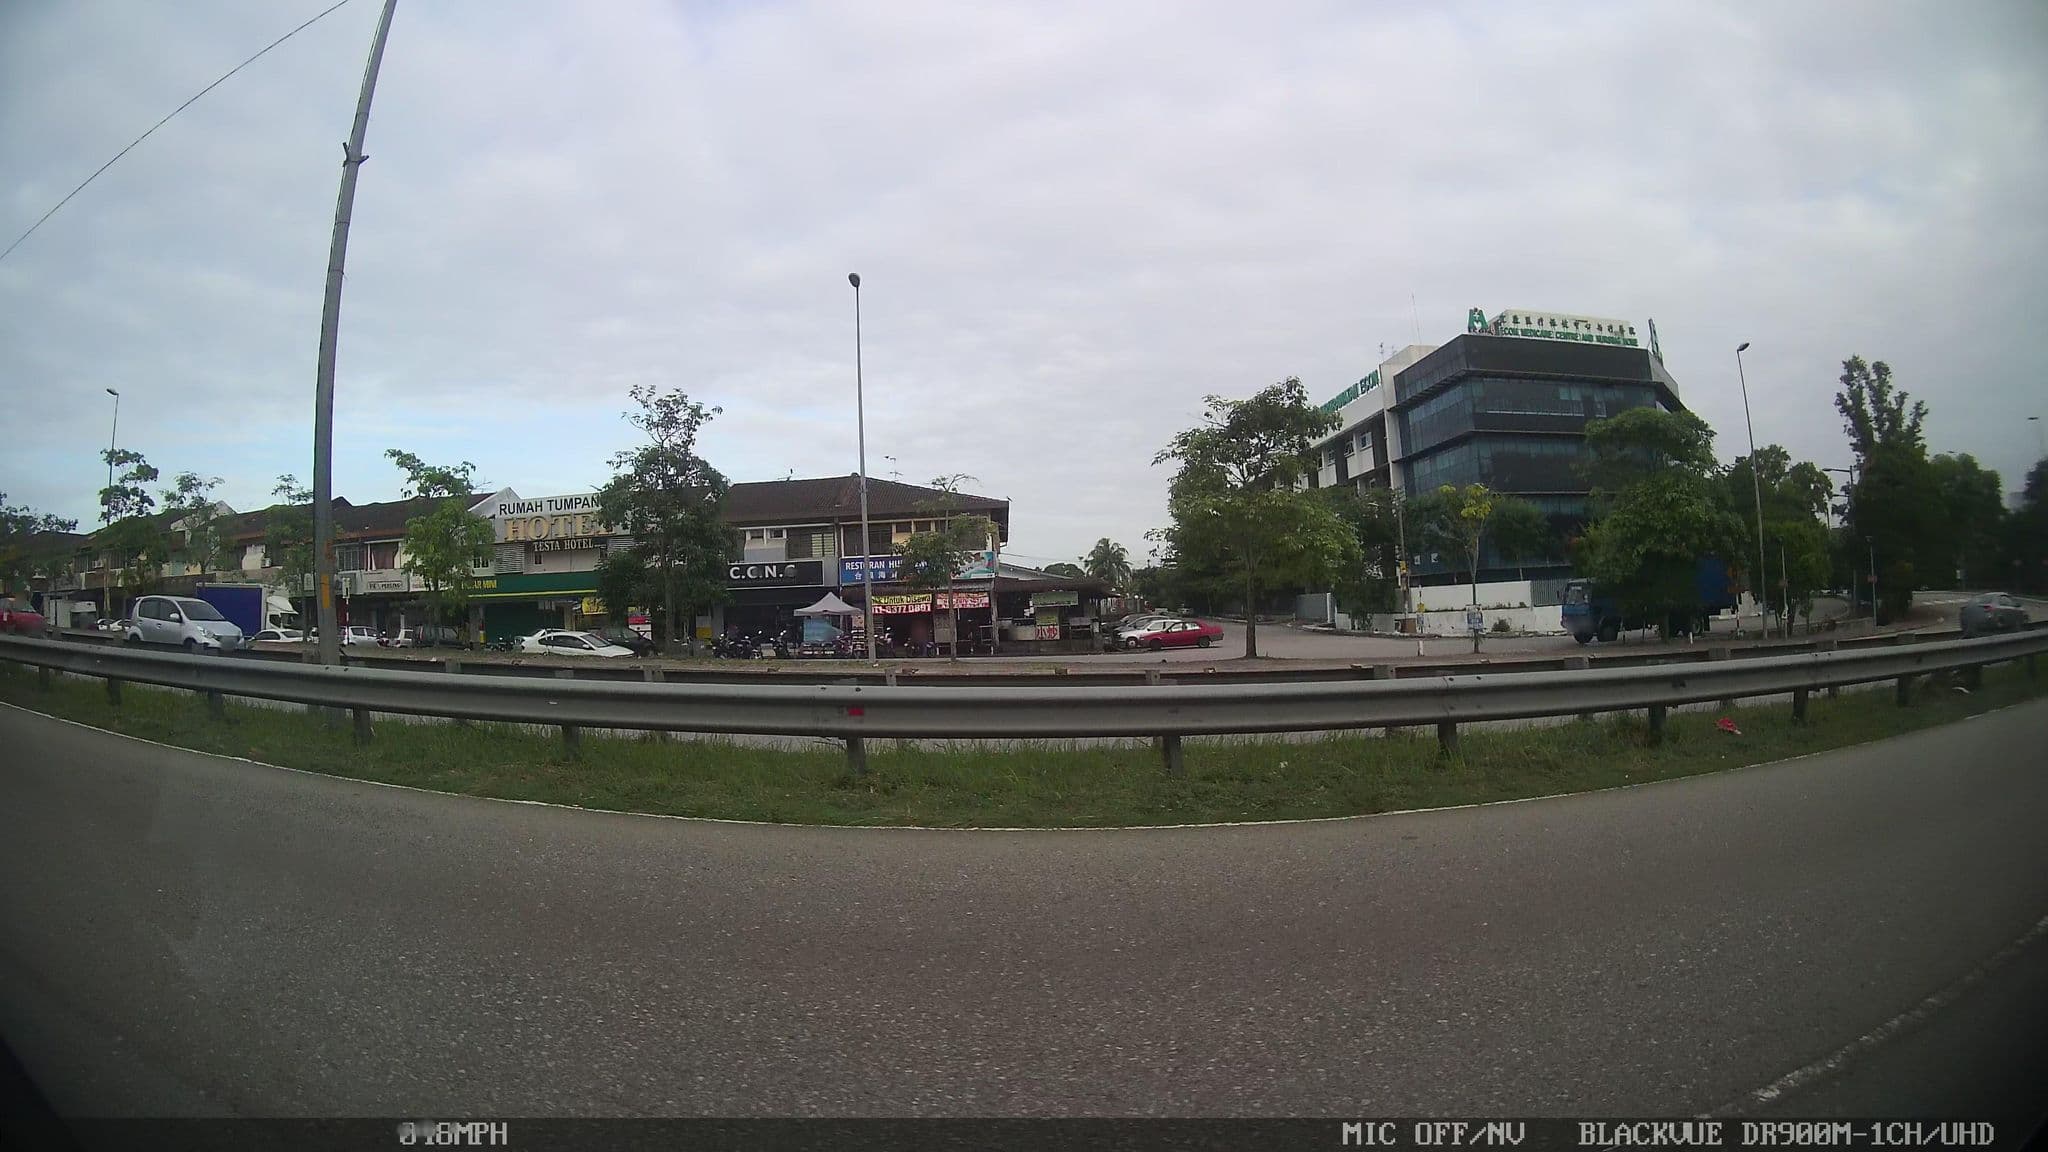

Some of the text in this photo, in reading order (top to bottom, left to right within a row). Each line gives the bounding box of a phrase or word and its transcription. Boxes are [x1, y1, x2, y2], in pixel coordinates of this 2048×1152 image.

[500, 496, 600, 515] RUMAH TUMPAN
[533, 538, 593, 552] TESTA HOTEL
[845, 559, 885, 571] RESTRAN
